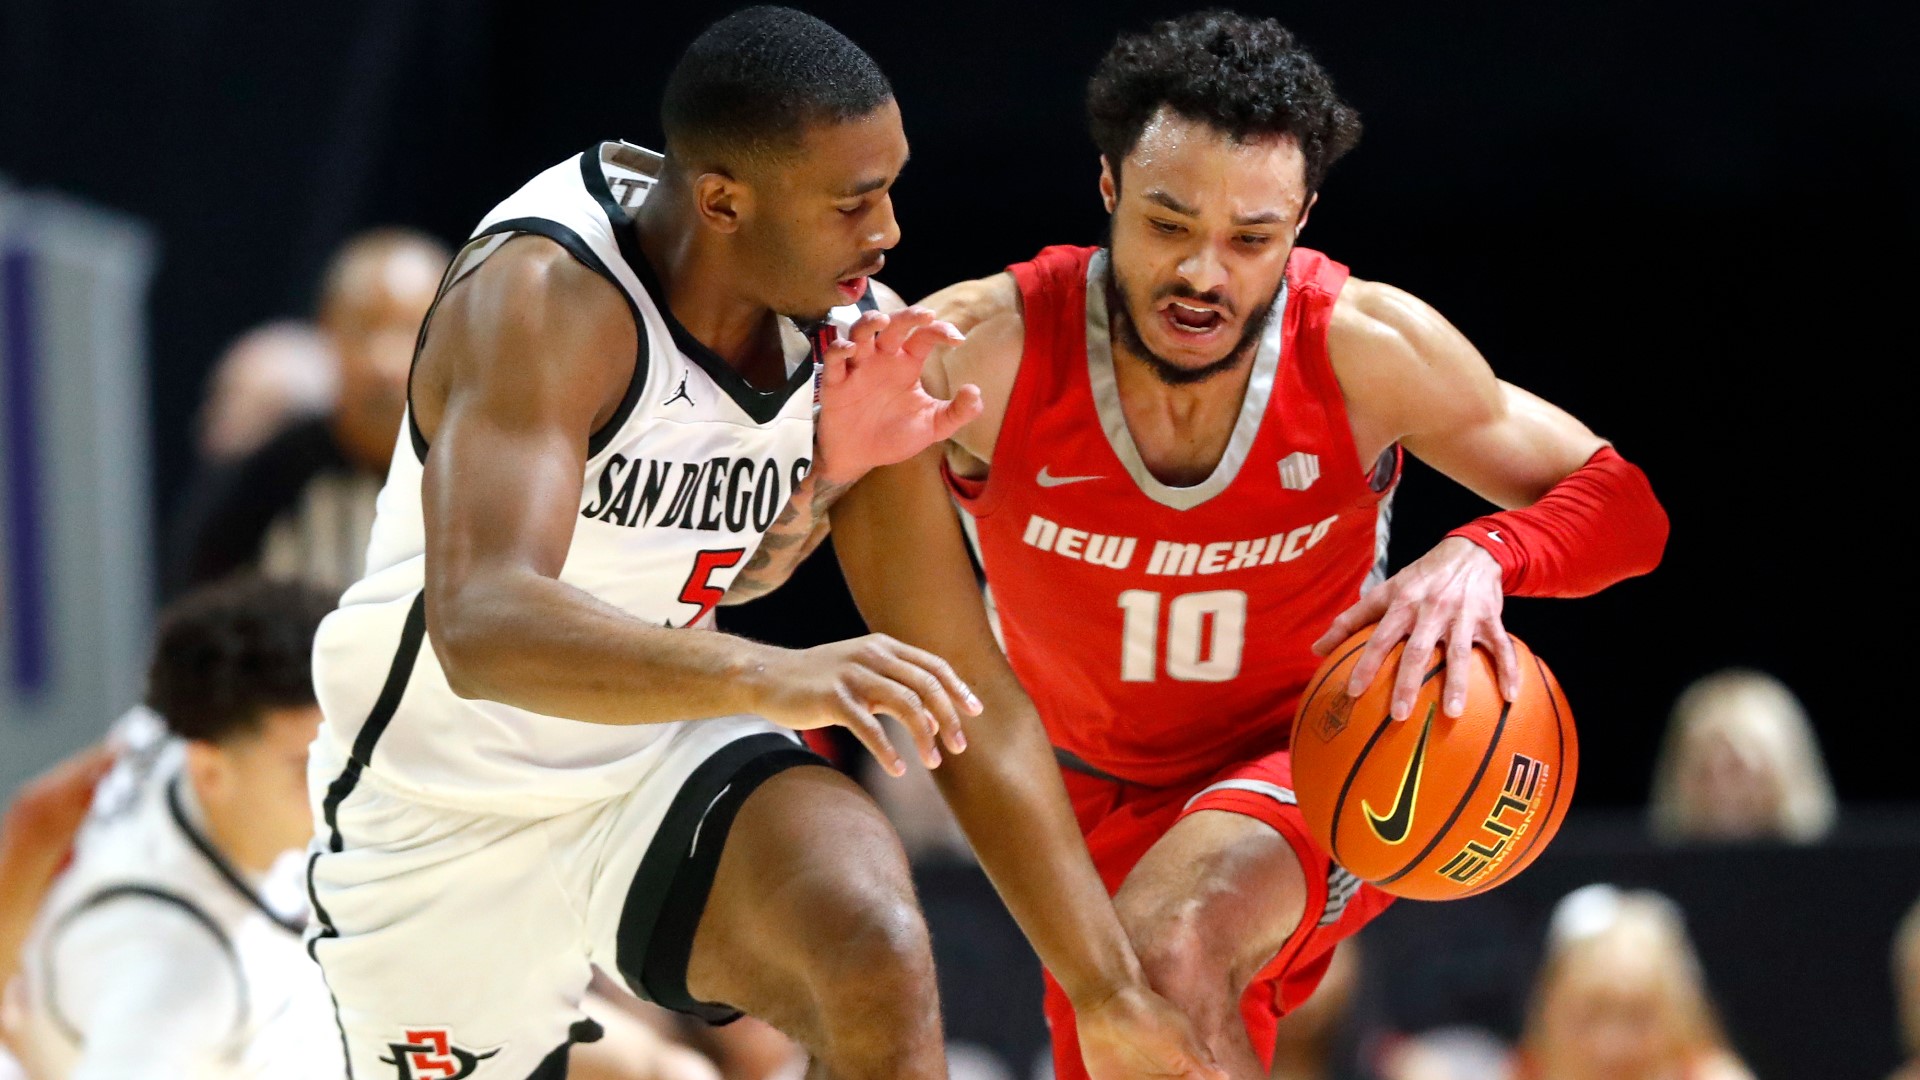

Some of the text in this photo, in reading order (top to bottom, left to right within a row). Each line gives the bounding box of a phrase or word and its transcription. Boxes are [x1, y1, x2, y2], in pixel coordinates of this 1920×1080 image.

[581, 453, 672, 529] SAN
[656, 456, 780, 533] DIEGO
[1022, 514, 1339, 577] NEW MEXICO
[664, 547, 746, 629] 5
[1117, 589, 1248, 682] 10
[1435, 752, 1543, 884] ELITE
